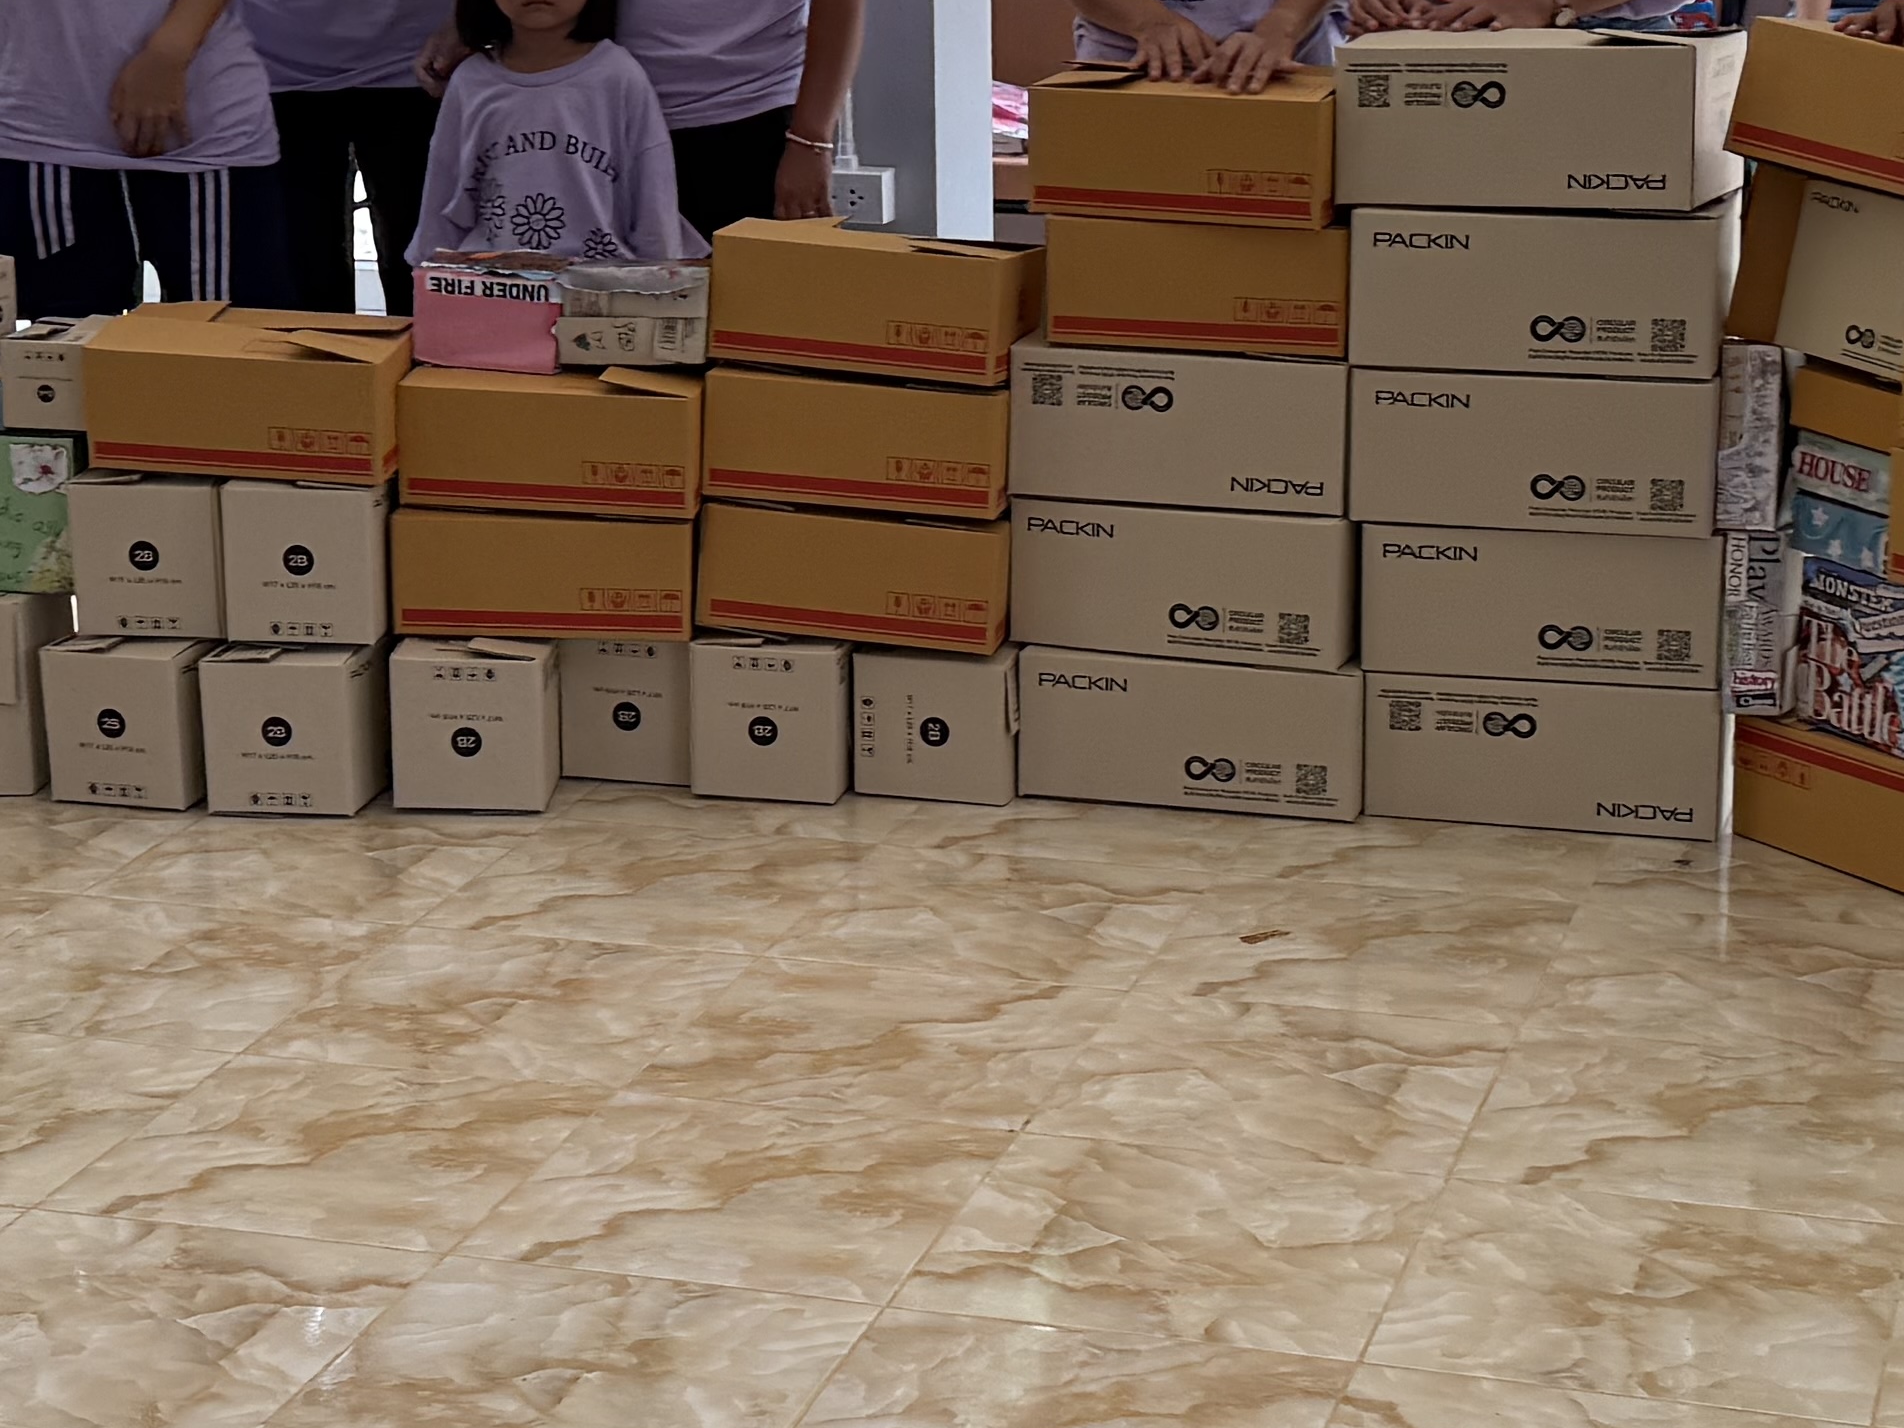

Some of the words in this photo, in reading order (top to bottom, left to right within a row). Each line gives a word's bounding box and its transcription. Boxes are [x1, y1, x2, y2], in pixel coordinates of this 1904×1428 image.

[504, 130, 557, 156] AND
[1566, 173, 1667, 192] PACKIN
[1372, 231, 1471, 251] PACKIN
[430, 276, 475, 296] FIRE
[482, 281, 550, 303] UNDER
[1373, 390, 1471, 410] PACKIN
[1798, 450, 1873, 493] HOUSE
[1229, 476, 1325, 498] PACKIN
[1025, 516, 1116, 540] PACKIN
[133, 549, 154, 563] 2B
[288, 554, 309, 567] 2B
[1381, 542, 1478, 564] PACKIN
[1728, 536, 1746, 598] HONOR
[1804, 616, 1864, 666] The
[1037, 670, 1129, 693] PACKIN
[455, 733, 477, 748] 2B
[753, 724, 775, 737] 2B
[1594, 801, 1694, 824] PACKIN
